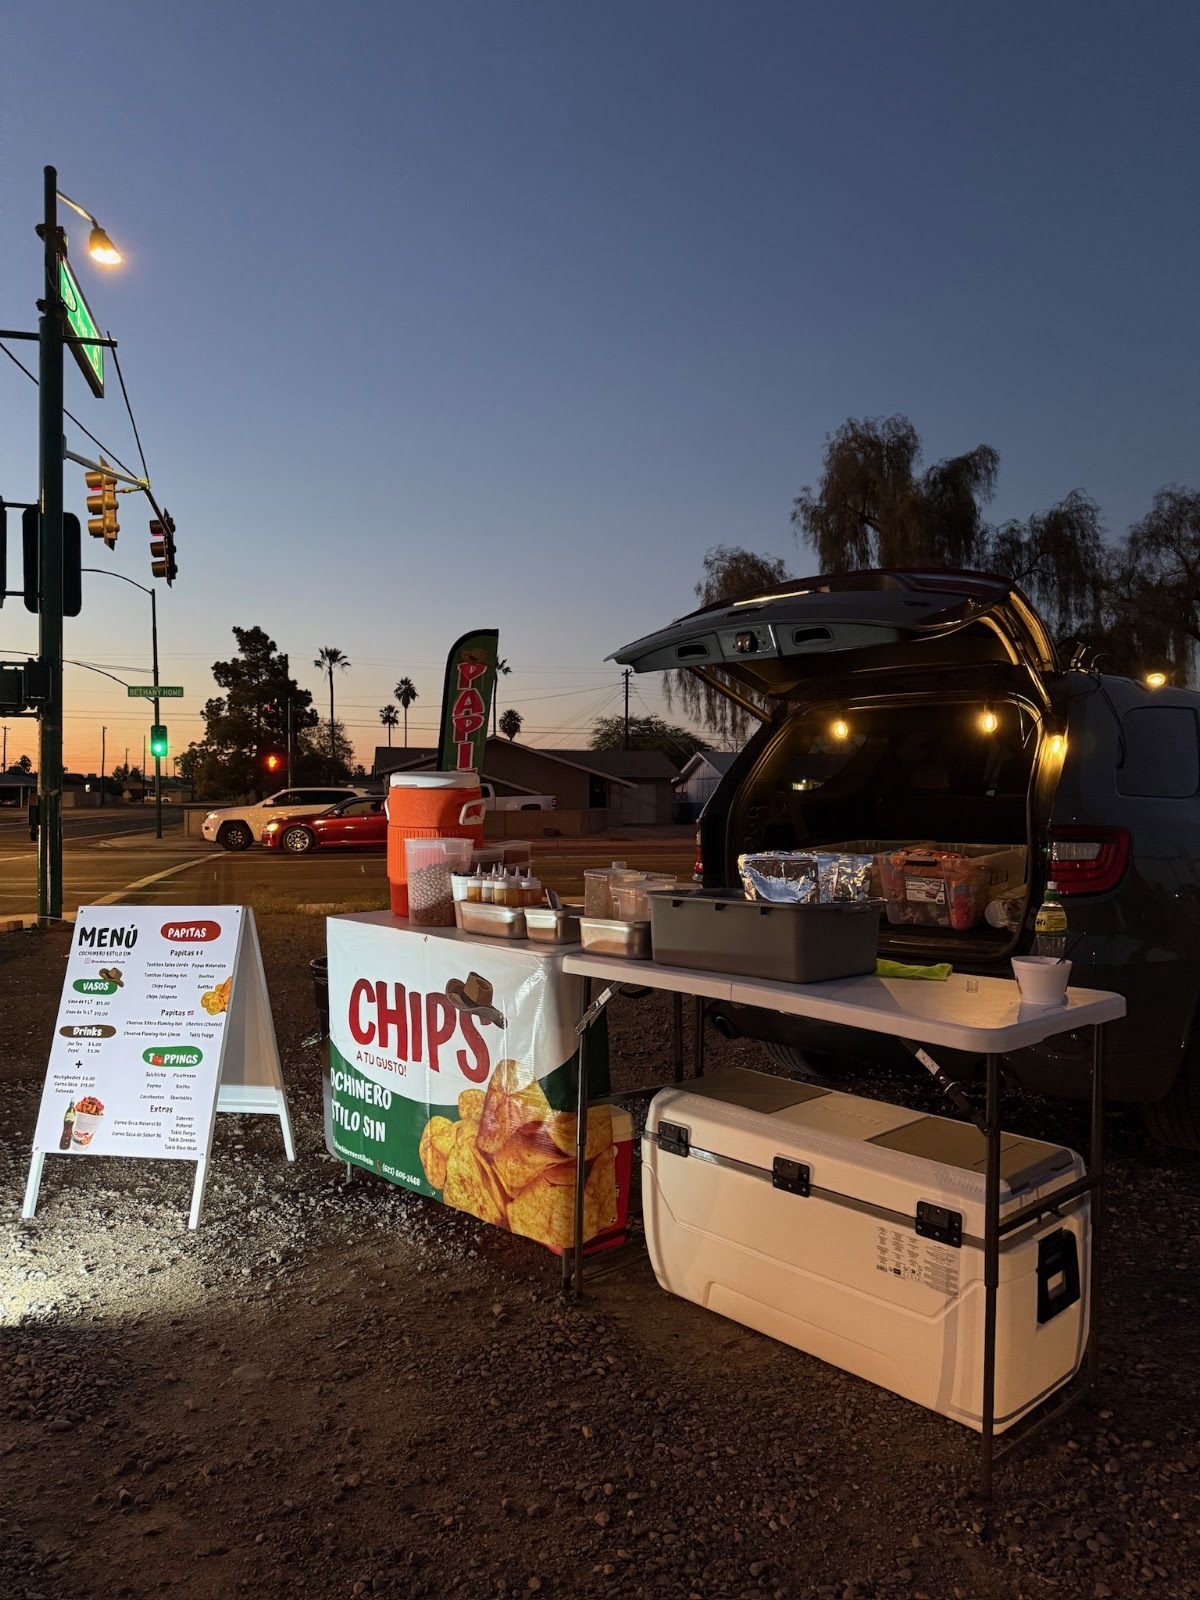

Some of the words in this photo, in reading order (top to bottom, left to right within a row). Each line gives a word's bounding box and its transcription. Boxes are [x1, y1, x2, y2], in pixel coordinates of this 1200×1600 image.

[130, 688, 161, 696] BETHANY
[452, 661, 487, 773] PAPI
[78, 924, 138, 949] MENÚ
[167, 927, 207, 938] PAPITAS
[170, 949, 195, 957] Papitas
[83, 981, 109, 991] VASOS
[160, 1009, 185, 1017] Papitas
[73, 1027, 102, 1036] Drinks
[348, 978, 492, 1084] CHIPS
[356, 1050, 363, 1061] A
[363, 1052, 375, 1065] TU
[376, 1056, 407, 1077] GUSTO!
[149, 1105, 173, 1113] Extras
[363, 1115, 386, 1142] SIN
[382, 1162, 395, 1177] (623)
